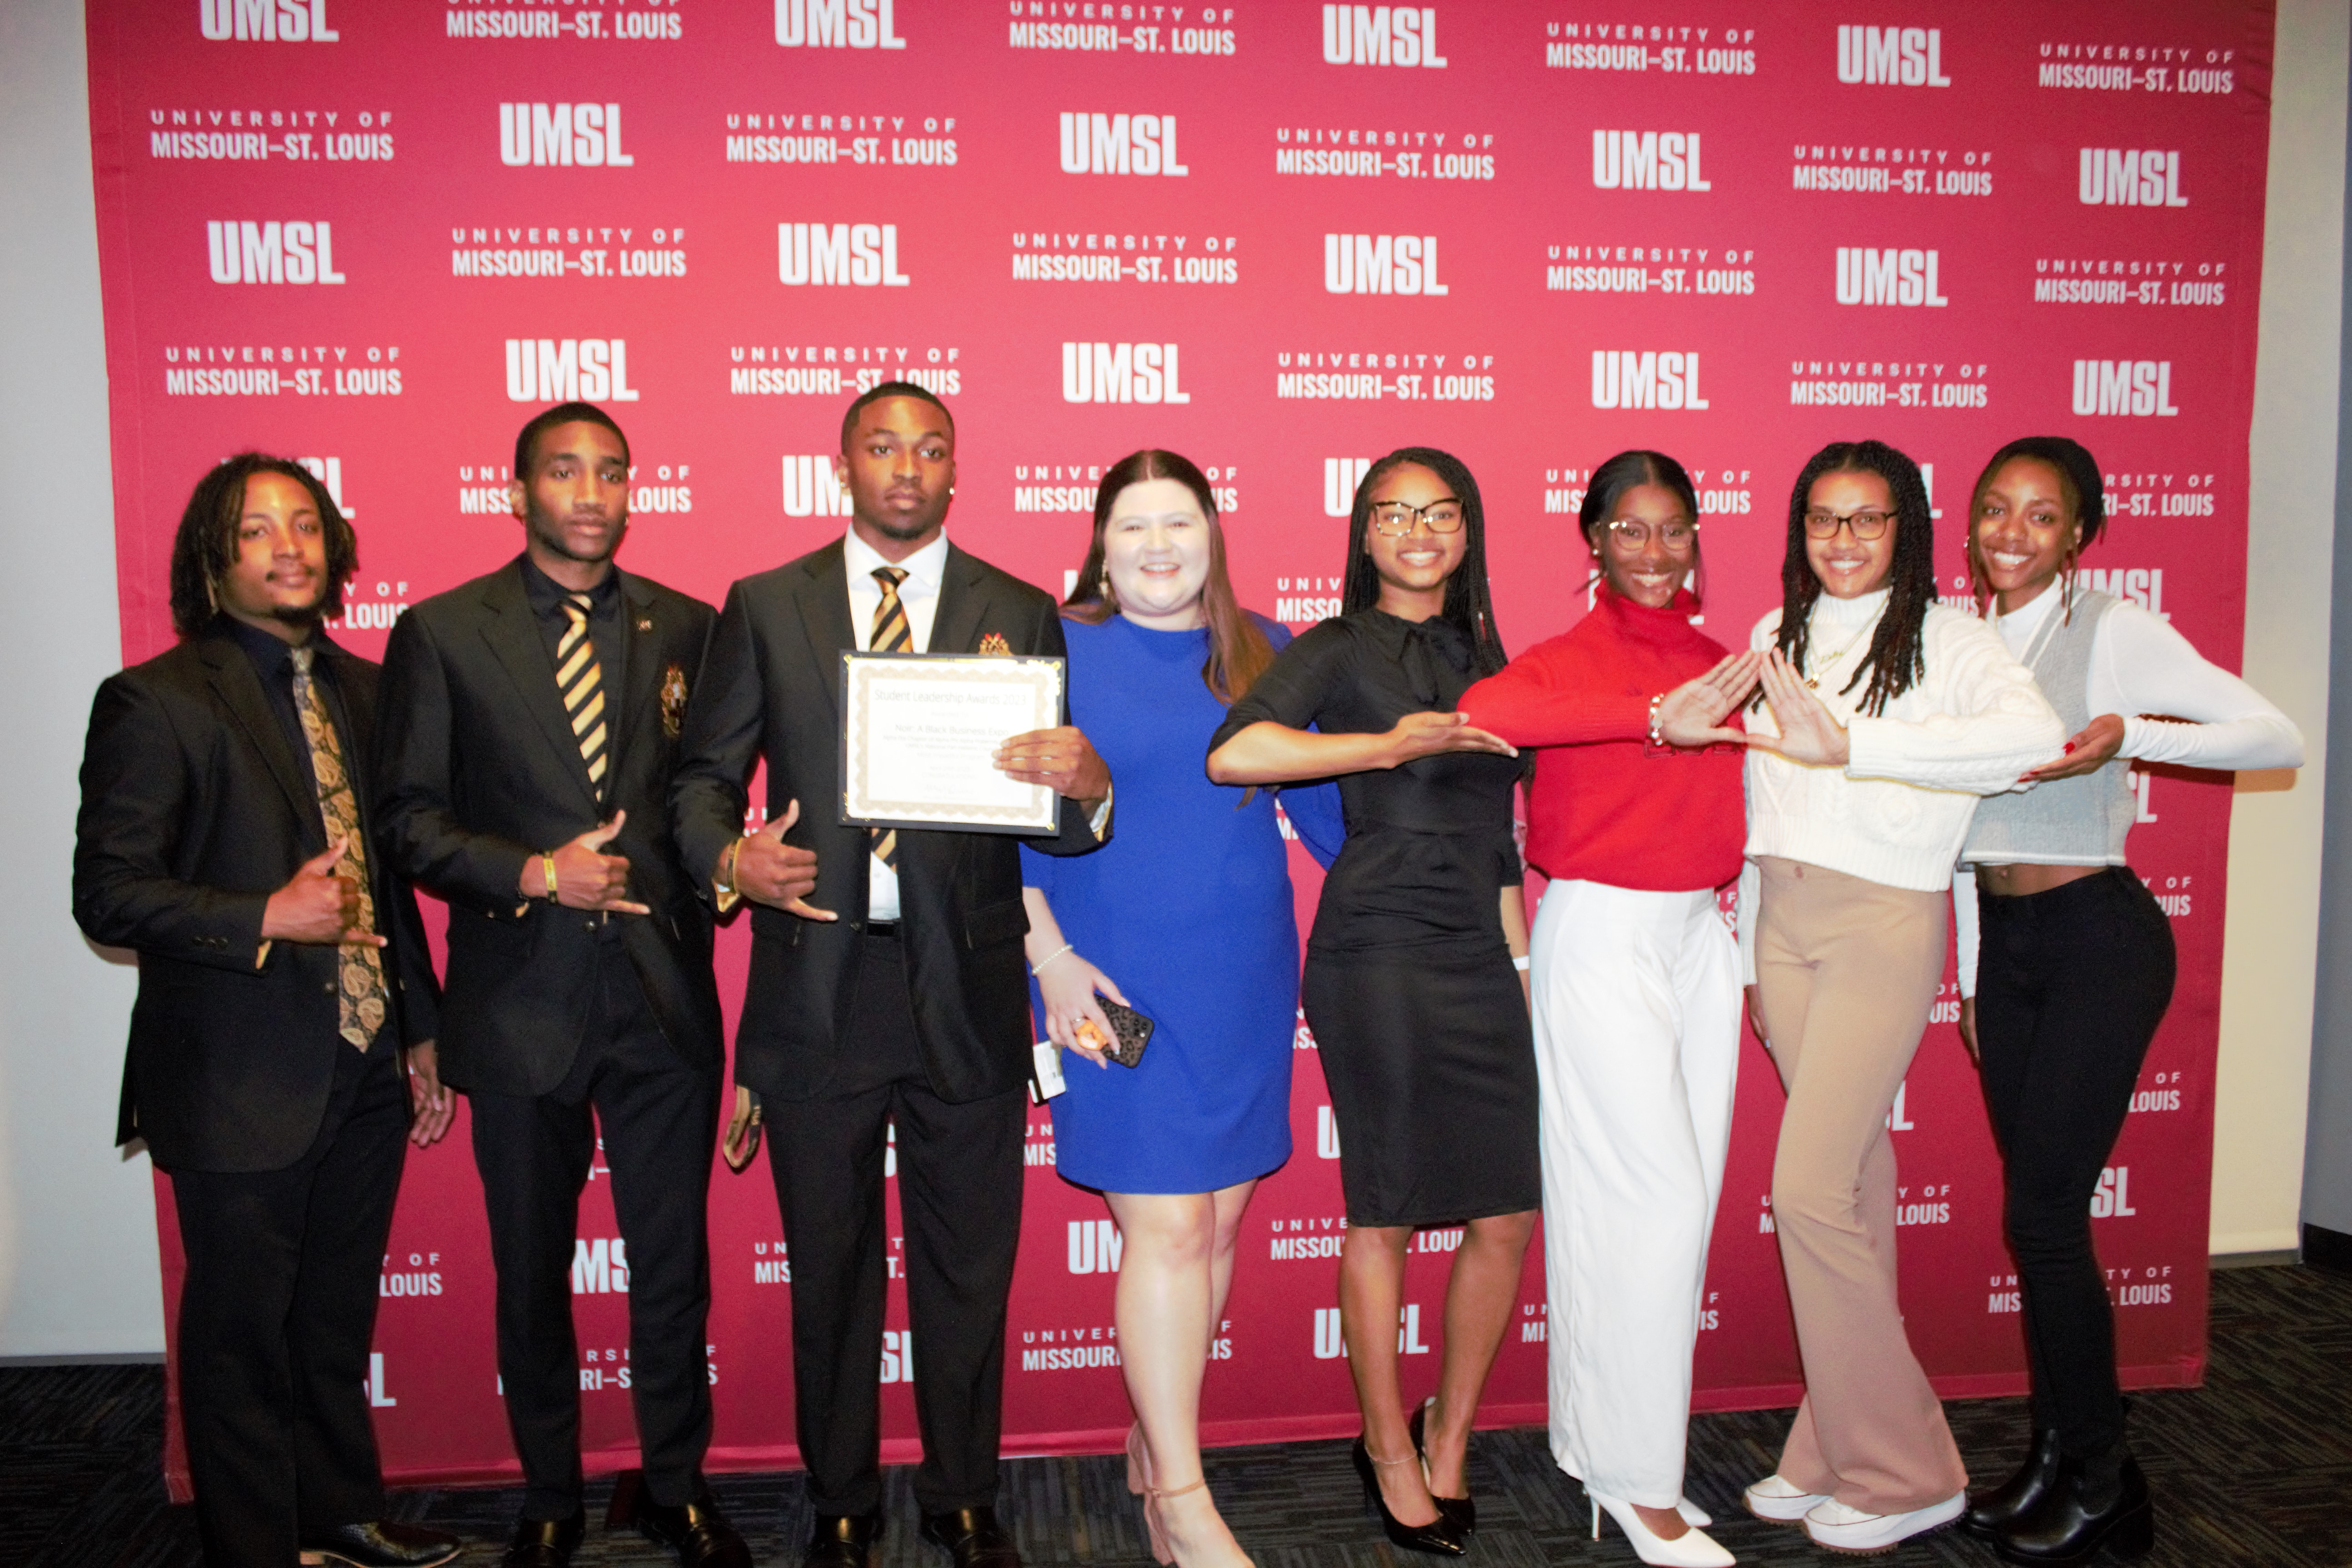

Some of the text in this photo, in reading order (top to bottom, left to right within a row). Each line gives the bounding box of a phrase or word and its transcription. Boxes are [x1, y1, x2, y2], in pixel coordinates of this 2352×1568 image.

[1009, 1, 1233, 23] UNIVERSITY OF
[616, 13, 681, 39] LOUIS
[1323, 5, 1447, 68] UMSL
[1547, 23, 1754, 43] UNIVERSITY OF
[1172, 29, 1235, 55] LOUIS
[1697, 49, 1755, 74] LOUIS
[1838, 26, 1950, 86] UMSL
[2040, 44, 2232, 64] UNIVERSITY OF
[2178, 70, 2232, 93] LOUIS
[151, 111, 391, 127] UNIVERSITY OF
[727, 115, 956, 133] UNIVERSITY OF
[500, 103, 633, 166] UMSL
[1060, 113, 1188, 176] UMSL
[1277, 128, 1493, 148] UNIVERSITY OF
[326, 134, 393, 160] LOUIS
[892, 139, 957, 165] LOUIS
[1794, 146, 1990, 165] UNIVERSITY OF
[1434, 154, 1494, 180] LOUIS
[1593, 130, 1710, 191] UMSL
[1936, 171, 1991, 195] LOUIS
[2080, 149, 2187, 206] UMSL
[452, 228, 684, 244] UNIVERSITY OF
[1013, 233, 1236, 252] UNIVERSITY OF
[208, 222, 345, 284] UMSL
[620, 250, 686, 276] LOUIS
[779, 224, 910, 286] UMSL
[1548, 246, 1754, 264] UNIVERSITY OF
[1175, 258, 1237, 283] LOUIS
[1325, 234, 1448, 295] UMSL
[2036, 260, 2224, 276] UNIVERSITY OF
[1697, 270, 1754, 294] LOUIS
[1836, 248, 1947, 306] UMSL
[2171, 283, 2224, 305] LOUIS
[166, 347, 399, 363] UNIVERSITY OF
[731, 347, 959, 363] UNIVERSITY OF
[1278, 353, 1494, 370] UNIVERSITY OF
[506, 339, 639, 402] UMSL
[1063, 343, 1190, 403] UMSL
[1592, 351, 1709, 409] UMSL
[1792, 362, 1987, 378] UNIVERSITY OF
[336, 369, 402, 395] LOUIS
[1434, 376, 1494, 400] LOUIS
[2073, 361, 2177, 416] UMSL
[1932, 384, 1987, 407] LOUIS
[657, 465, 690, 481] OF
[1722, 470, 1751, 484] OF
[2187, 475, 2214, 488] OF
[783, 456, 854, 516] UM
[2162, 494, 2213, 515] LOUIS
[376, 582, 408, 597] OF
[874, 689, 1027, 706] Student Leadership Awards 2023
[925, 725, 947, 734] Black
[950, 726, 986, 735] Business
[988, 727, 1009, 737] Expo
[2166, 877, 2191, 889] OF
[2155, 1072, 2180, 1084] OF
[1923, 1185, 1950, 1197] OF
[1896, 1203, 1949, 1225] LOUIS
[409, 1253, 440, 1266] OF
[2146, 1266, 2171, 1278] OF
[379, 1273, 442, 1296] LOUIS
[2120, 1284, 2171, 1305] LOUIS
